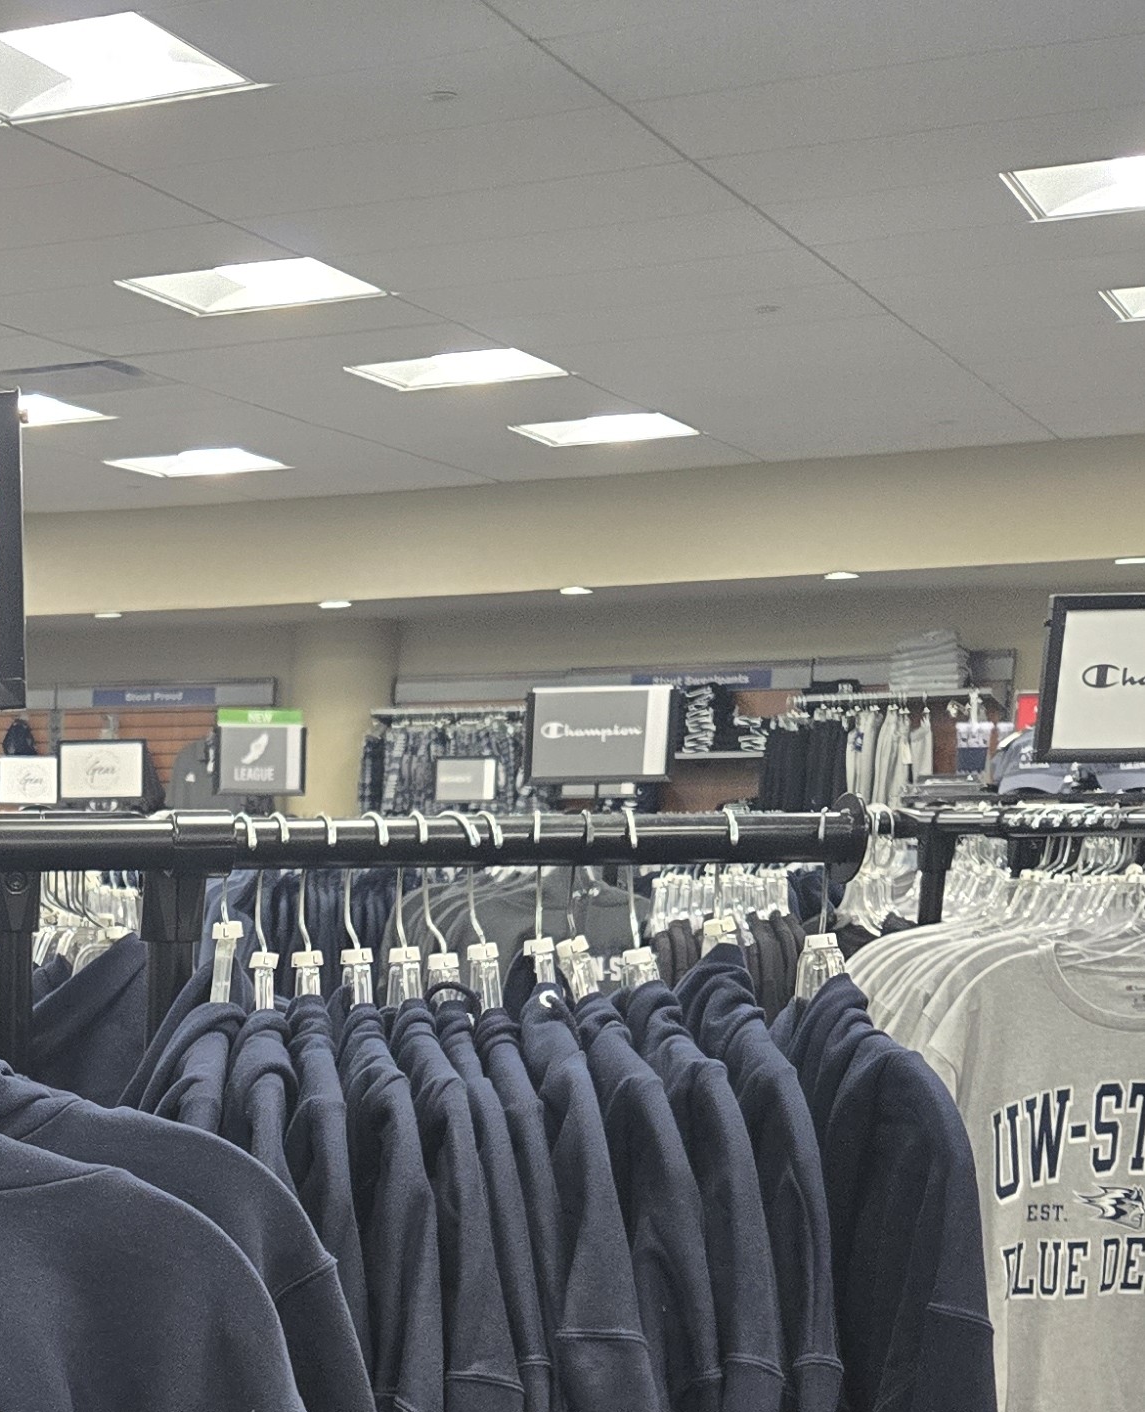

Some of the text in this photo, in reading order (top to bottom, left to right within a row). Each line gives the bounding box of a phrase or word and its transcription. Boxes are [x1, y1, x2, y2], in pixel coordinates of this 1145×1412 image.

[247, 711, 273, 724] NEW
[540, 720, 643, 743] Champion
[233, 767, 275, 782] LEAGUE
[1026, 1203, 1069, 1223] EST.
